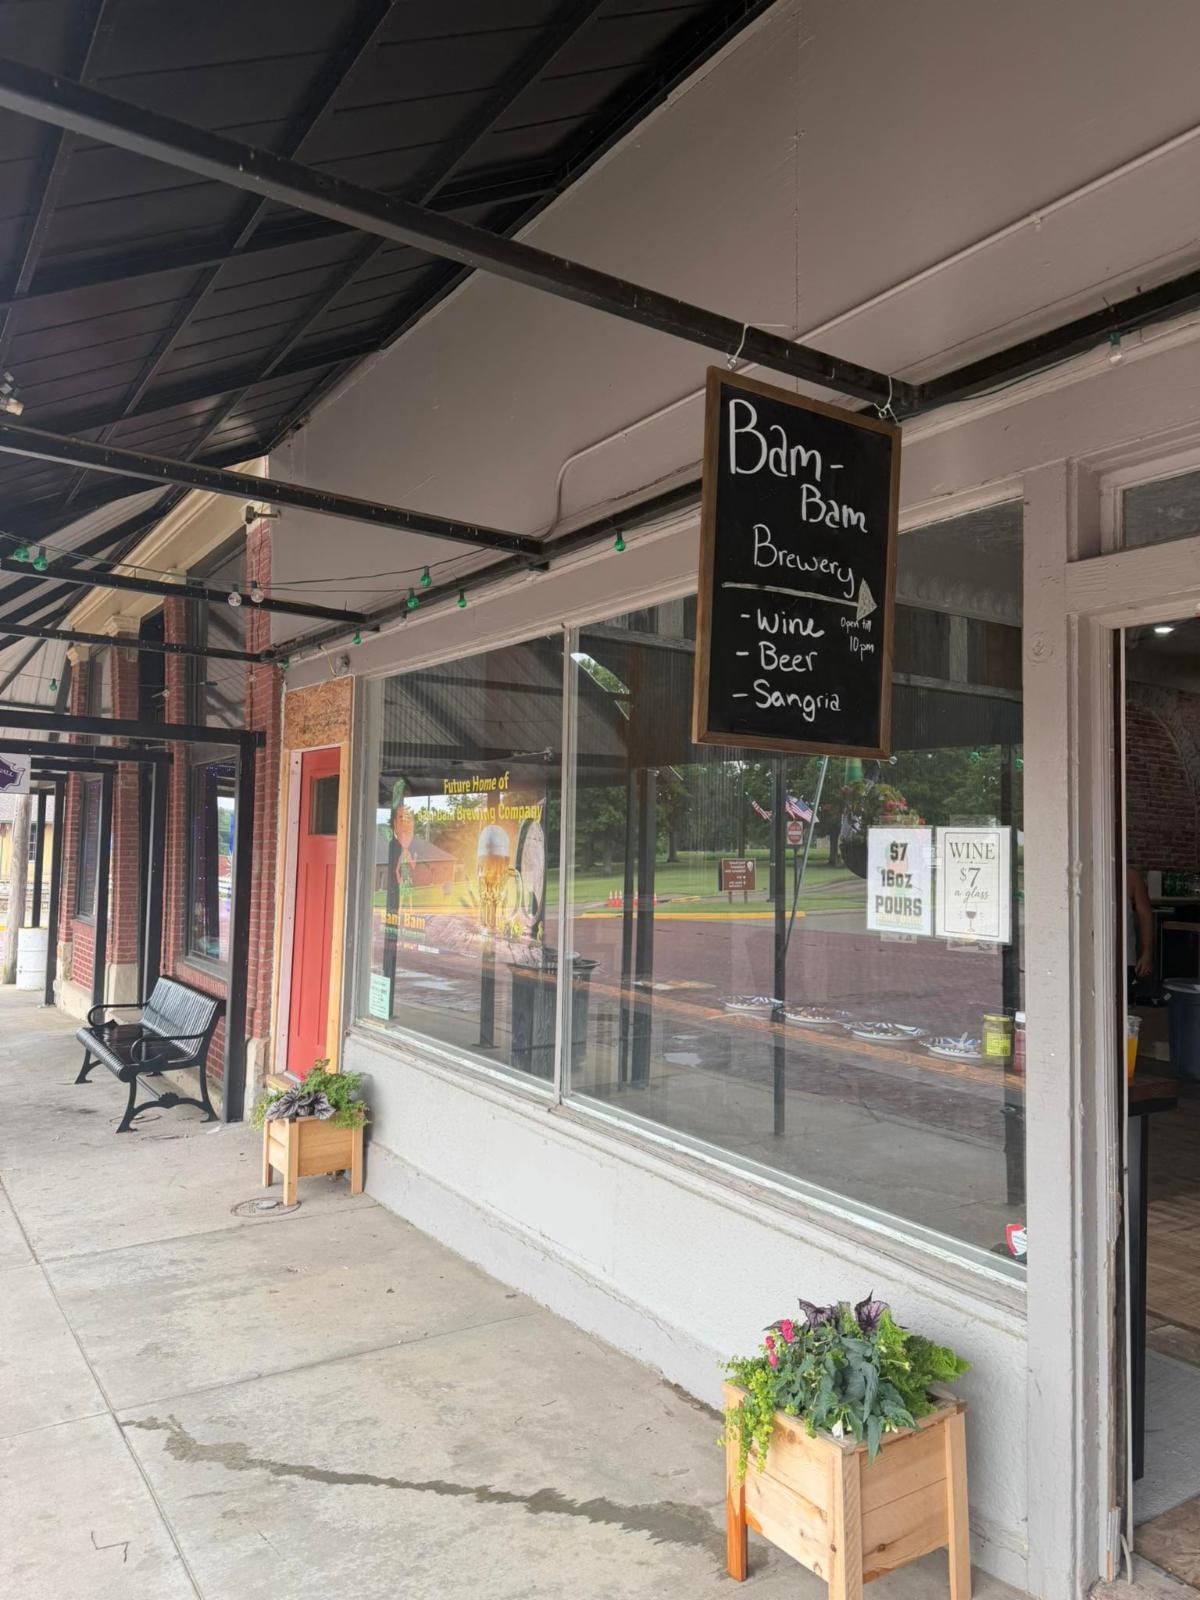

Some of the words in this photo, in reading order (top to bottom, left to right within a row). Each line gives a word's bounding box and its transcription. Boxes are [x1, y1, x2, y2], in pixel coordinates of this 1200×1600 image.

[800, 483, 868, 533] Bam
[753, 523, 854, 598] Brewery
[840, 616, 860, 634] Open
[758, 640, 818, 672] Beer
[753, 678, 841, 722] Sangria
[443, 778, 471, 794] Future
[472, 775, 496, 791] Home
[498, 771, 510, 789] of
[456, 804, 495, 823] Brewing
[498, 803, 543, 823] Company
[889, 840, 908, 862] $7
[949, 842, 995, 860] WINE
[960, 867, 981, 888] $7
[954, 889, 962, 897] a
[964, 886, 990, 903] glass
[875, 895, 922, 916] POURS
